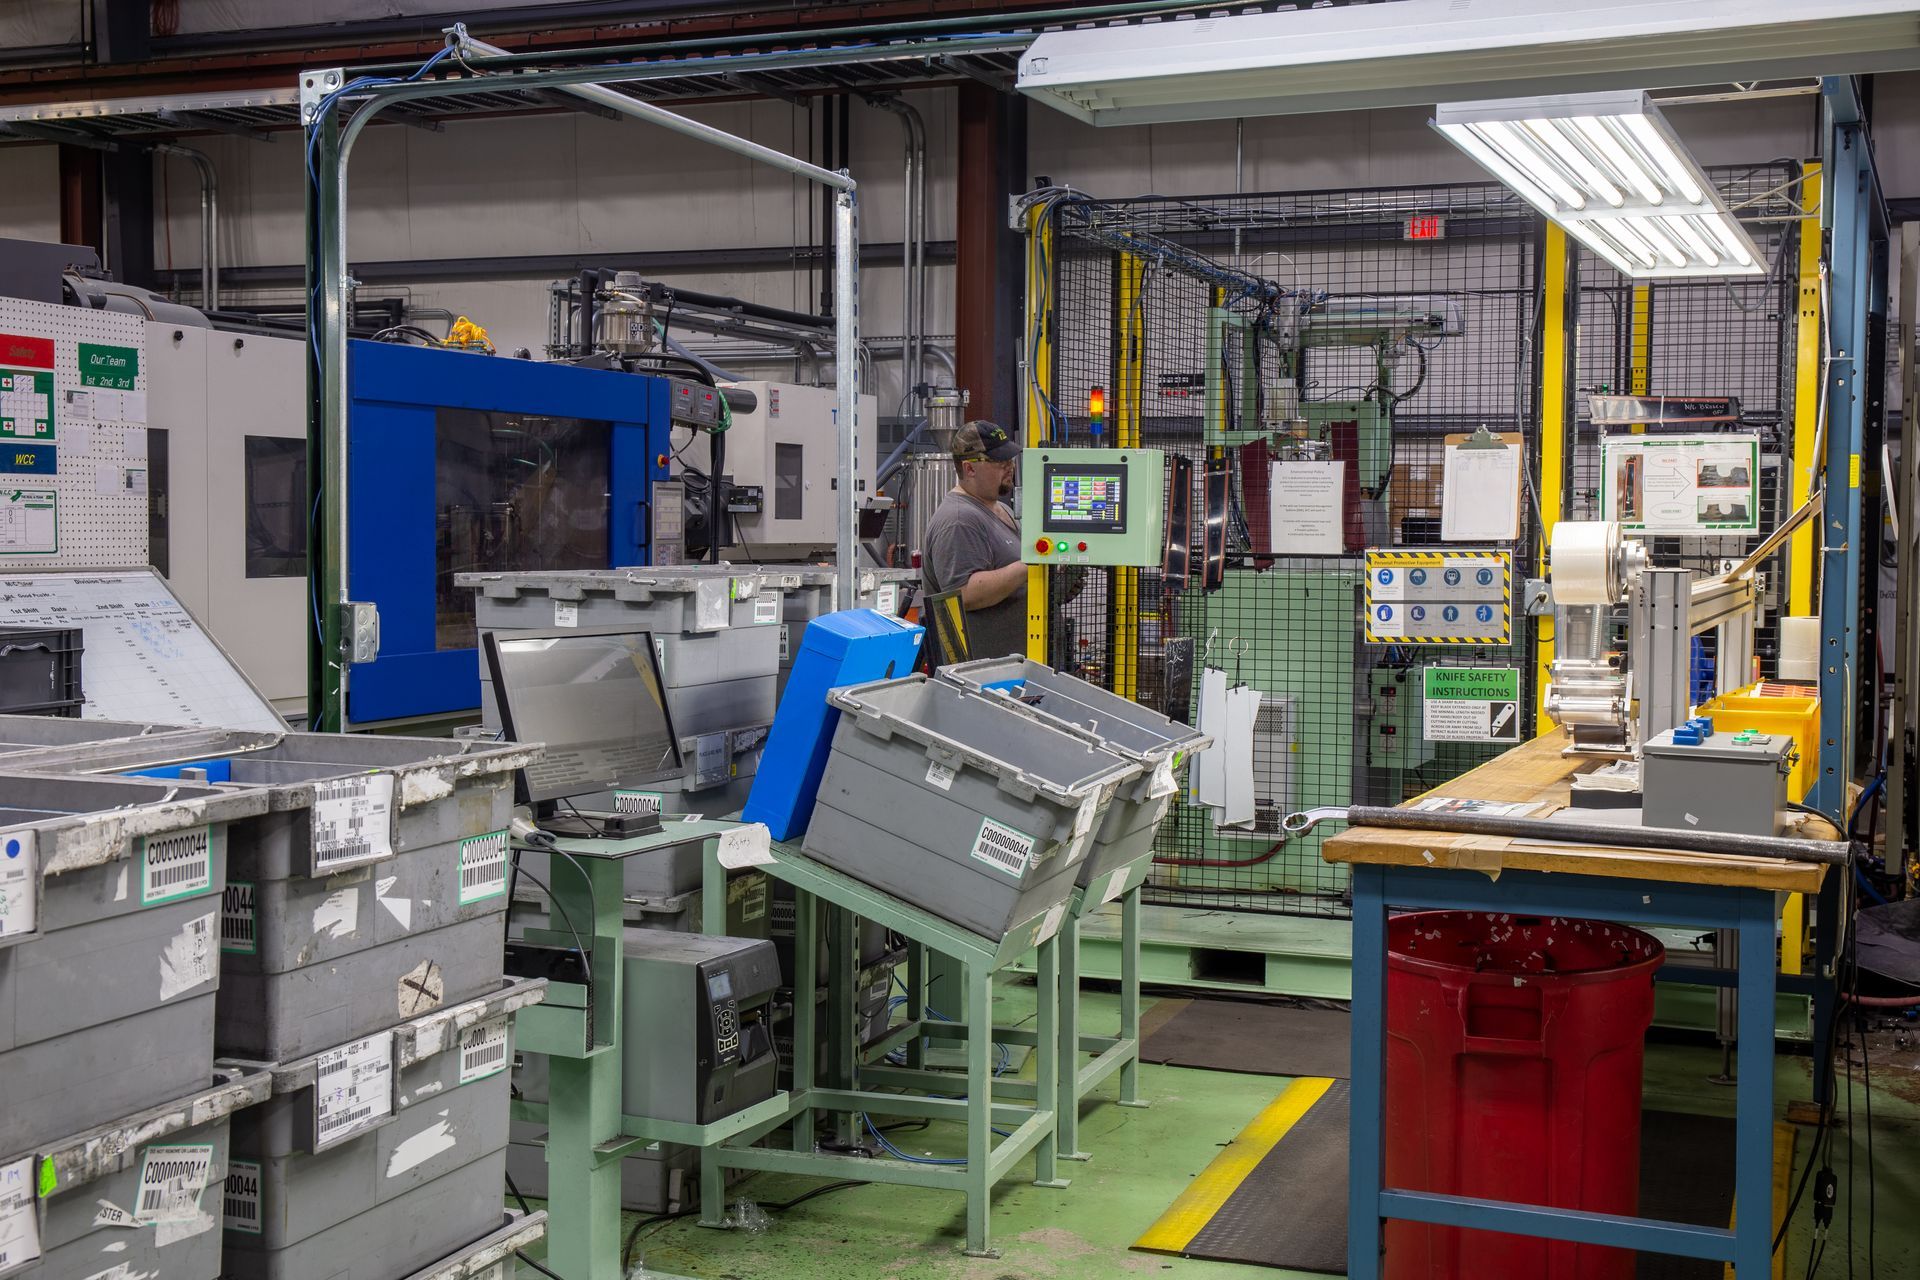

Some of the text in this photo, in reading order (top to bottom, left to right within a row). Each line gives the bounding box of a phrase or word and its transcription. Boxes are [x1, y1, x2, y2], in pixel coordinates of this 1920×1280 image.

[1411, 215, 1439, 238] EXIT
[9, 346, 36, 359] Safety
[90, 354, 126, 367] Our Team
[86, 375, 131, 388] 1st 2nd 3rd
[15, 453, 36, 465] WCC
[1436, 672, 1507, 682] KNIFE SAFETY
[1432, 687, 1510, 697] INSTRUCTIONS
[614, 796, 661, 814] C000000044
[148, 832, 207, 866] C000000044
[981, 826, 1029, 858] C000000044
[461, 834, 507, 866] C000000044
[222, 885, 256, 915] 0044
